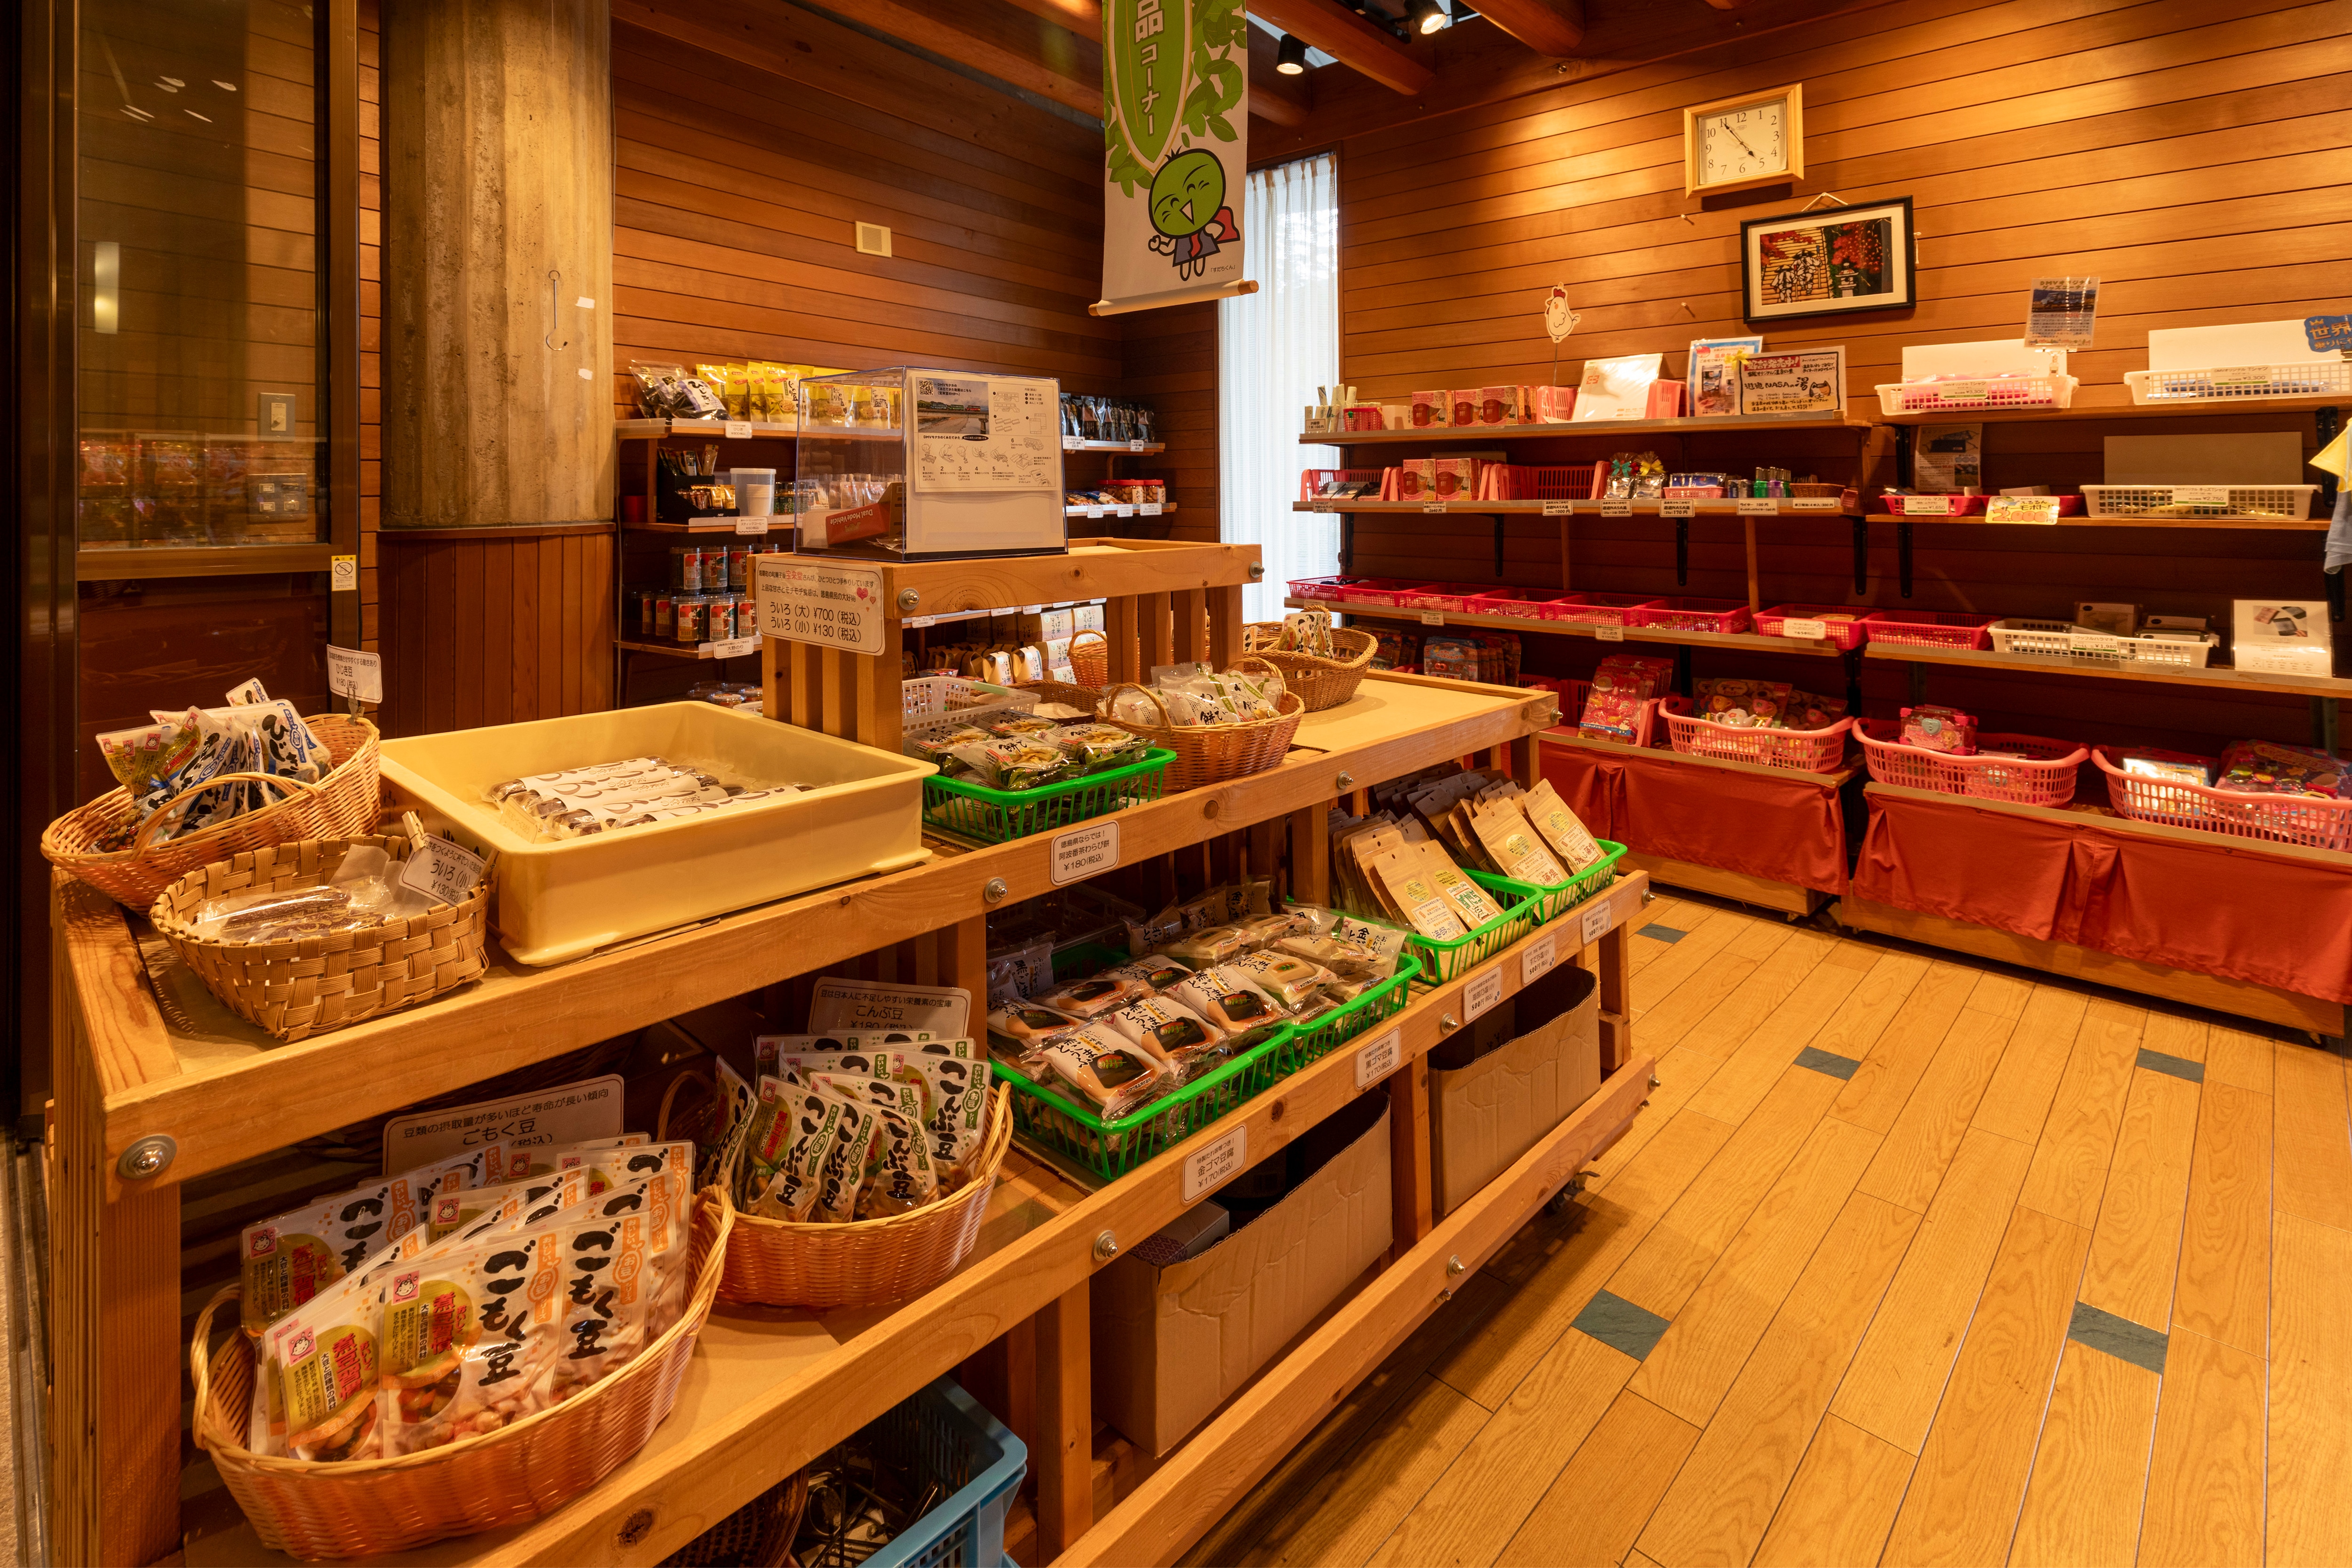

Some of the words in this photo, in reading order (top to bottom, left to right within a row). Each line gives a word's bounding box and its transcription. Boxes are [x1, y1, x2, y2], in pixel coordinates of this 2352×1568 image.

[1719, 118, 1727, 127] 11
[1736, 112, 1747, 123] 12
[1758, 110, 1763, 119] 1
[1771, 115, 1777, 125] 2
[1707, 127, 1716, 138] 10
[1773, 131, 1779, 141] 3
[1706, 144, 1711, 154] 9
[1771, 147, 1777, 157] 4
[1708, 159, 1714, 168] 8
[1721, 165, 1727, 175] 7
[1740, 163, 1746, 173] 6
[1759, 158, 1764, 168] 5
[830, 515, 848, 525] Vehicle
[846, 512, 860, 522] Mode
[860, 508, 873, 517] Dual
[336, 664, 353, 677] ひじき豆
[1061, 830, 1105, 848] 徳島県ならでは!
[1059, 840, 1109, 860] 阿波番茶わらび餅
[1064, 852, 1104, 871] ¥180(税込)
[821, 989, 953, 1008] 豆は日本人に不足しやすい栄養素の宝庫
[856, 1005, 905, 1020] こんぶ豆
[1366, 1046, 1393, 1070] 黒ゴマ豆腐
[1366, 1058, 1392, 1079] ¥170(税込)
[966, 1092, 979, 1107] お豆
[403, 1088, 609, 1138] 豆類の摂取量が多いほど寿命が長い傾向
[826, 1106, 837, 1127] おいしい
[929, 1060, 967, 1161] こんぶ豆
[463, 1117, 536, 1146] ごもく豆
[776, 1095, 826, 1207] こんぶ豆
[813, 1135, 826, 1152] お豆
[1197, 1146, 1234, 1176] 金ゴマ豆腐
[1198, 1161, 1233, 1188] ¥170(税込)
[627, 1219, 636, 1244] おいしい
[542, 1236, 553, 1262] おいしい
[620, 1256, 635, 1278] お豆
[535, 1273, 549, 1296] お豆
[568, 1221, 621, 1360] ごもく豆
[455, 1305, 467, 1335] おいしく
[478, 1239, 536, 1387] ごもく豆
[419, 1303, 430, 1360] 大豆と四種類の具材
[431, 1291, 456, 1355] 煮豆習慣
[359, 1341, 373, 1371] おいしく
[333, 1333, 364, 1402] 煮豆習慣
[321, 1352, 337, 1411] 大豆と四種類の具材
